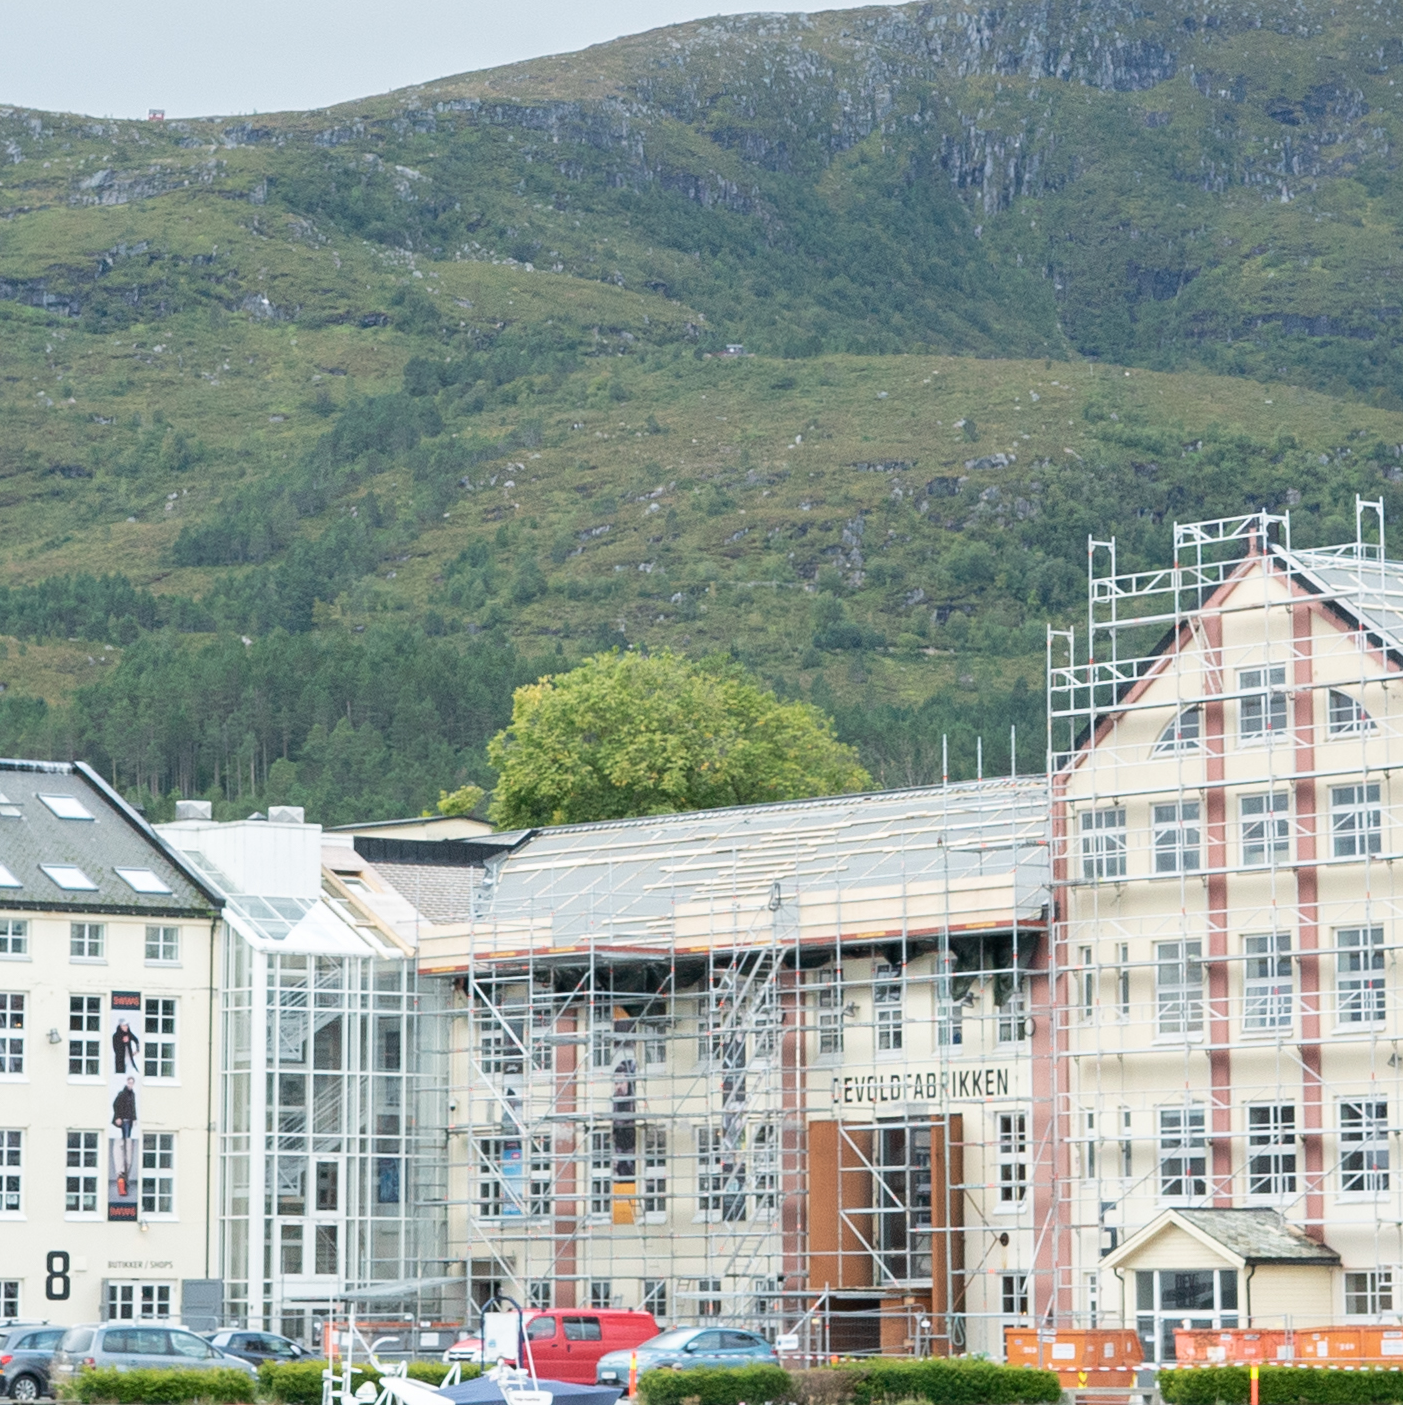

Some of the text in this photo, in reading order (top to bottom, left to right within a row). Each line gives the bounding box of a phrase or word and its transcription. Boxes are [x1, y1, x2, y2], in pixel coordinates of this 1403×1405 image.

[46, 1251, 70, 1300] 8
[108, 1261, 143, 1269] BUTIKKER
[150, 1261, 173, 1269] SHOPS
